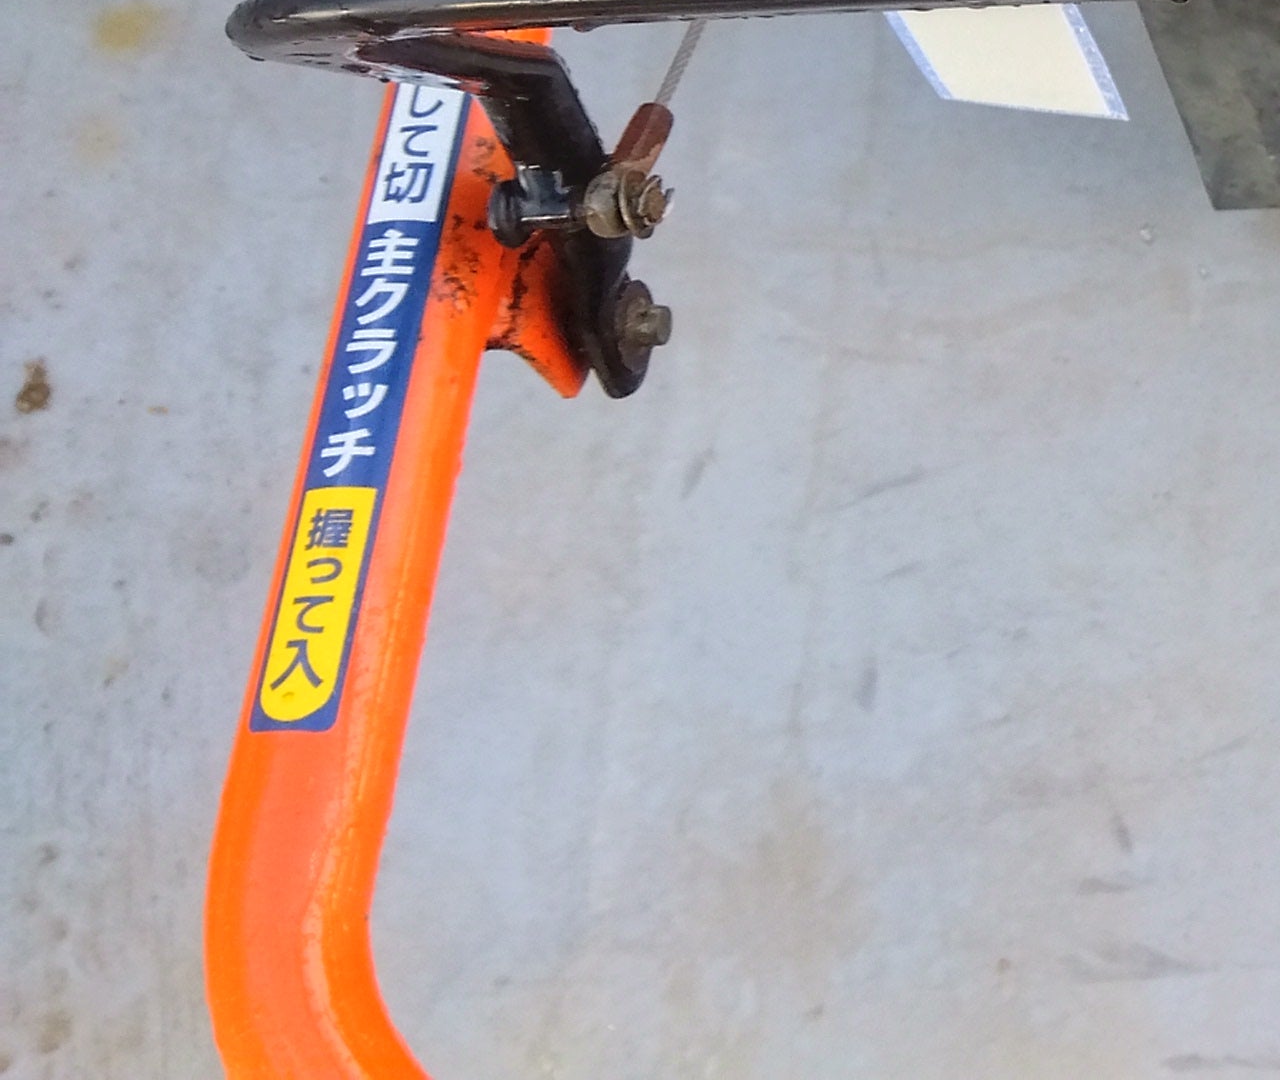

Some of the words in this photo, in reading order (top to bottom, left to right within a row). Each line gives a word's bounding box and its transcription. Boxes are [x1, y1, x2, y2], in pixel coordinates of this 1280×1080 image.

[320, 229, 420, 477] 主クラッチ
[270, 508, 354, 689] 握って入
